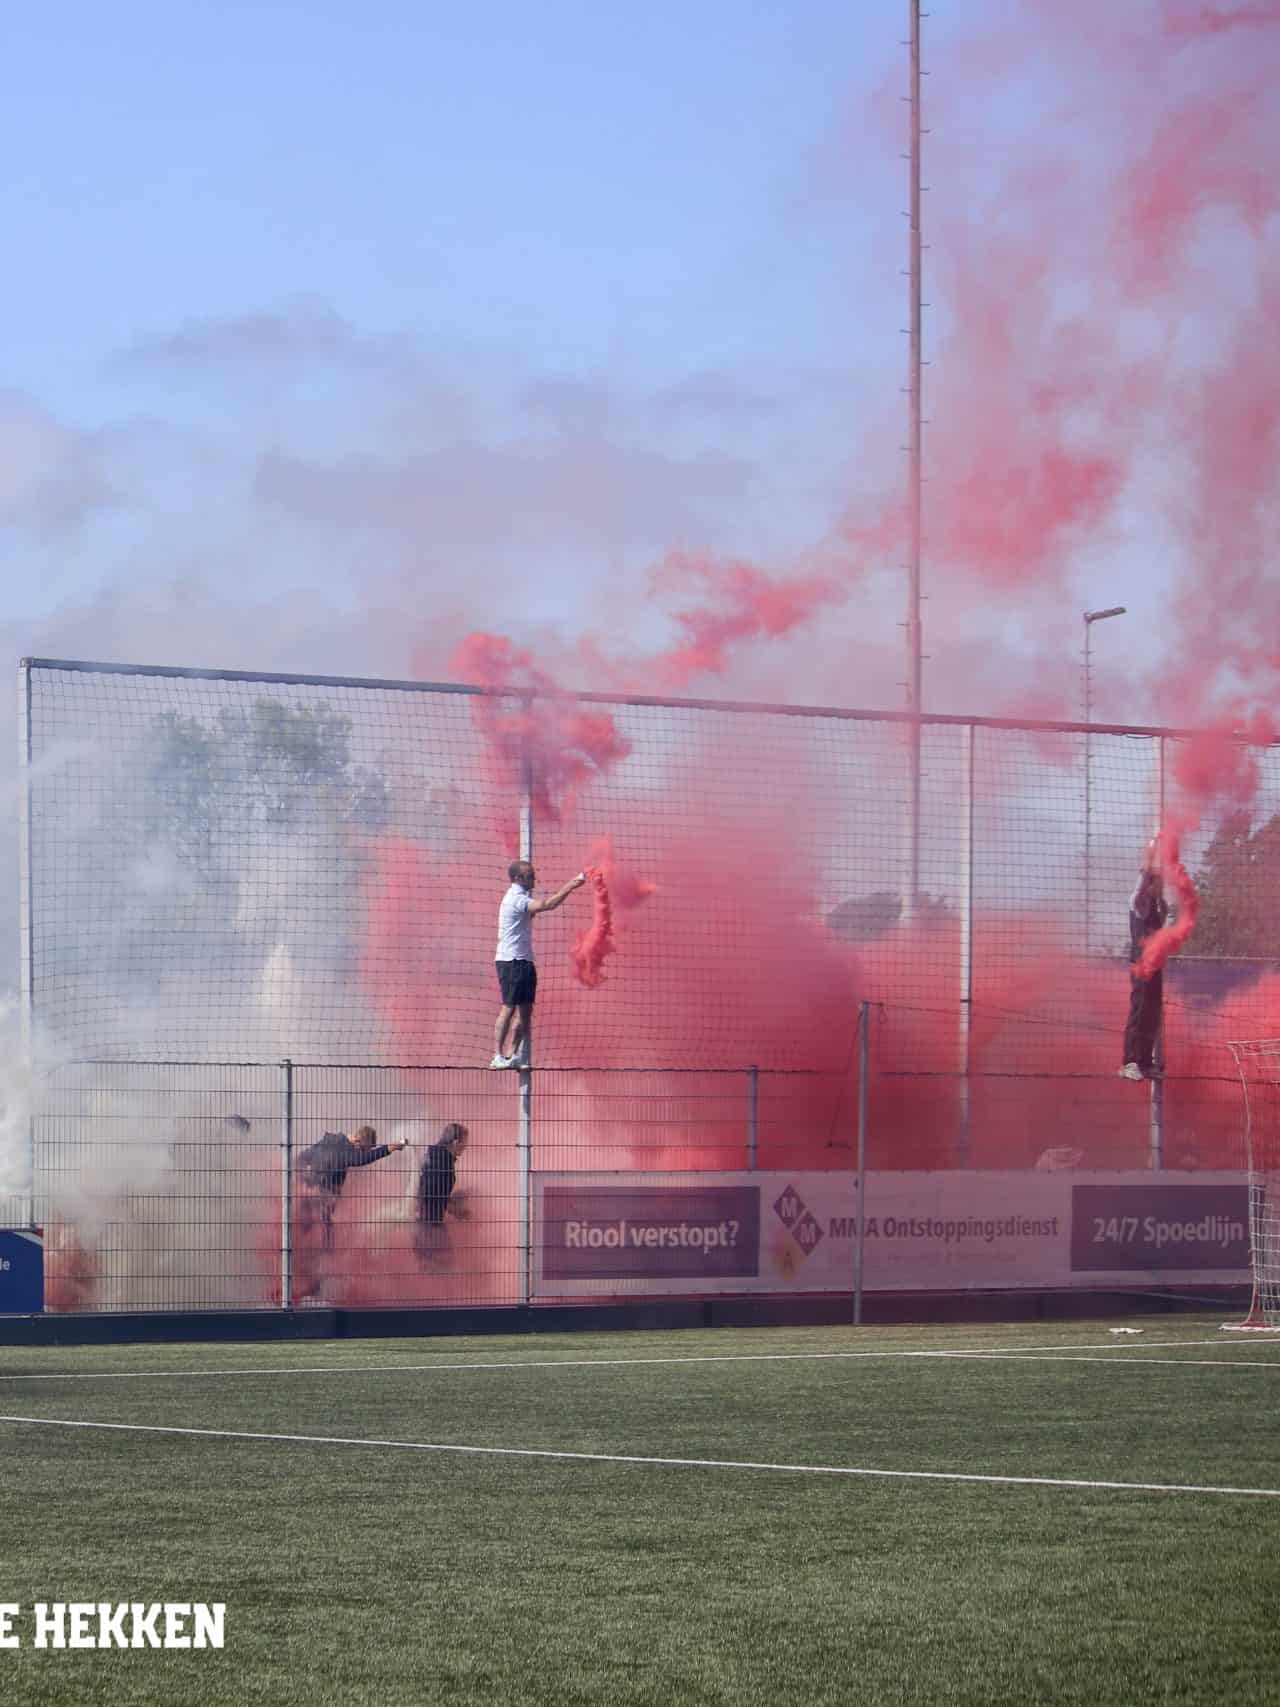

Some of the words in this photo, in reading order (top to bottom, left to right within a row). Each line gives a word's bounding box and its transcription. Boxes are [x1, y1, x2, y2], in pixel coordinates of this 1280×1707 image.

[564, 1220, 626, 1249] Riool
[630, 1220, 740, 1254] verstopt?
[883, 1215, 1059, 1243] Ontstoppingsdienst
[1092, 1216, 1139, 1246] 24/7
[1142, 1215, 1245, 1248] Spoedlijn
